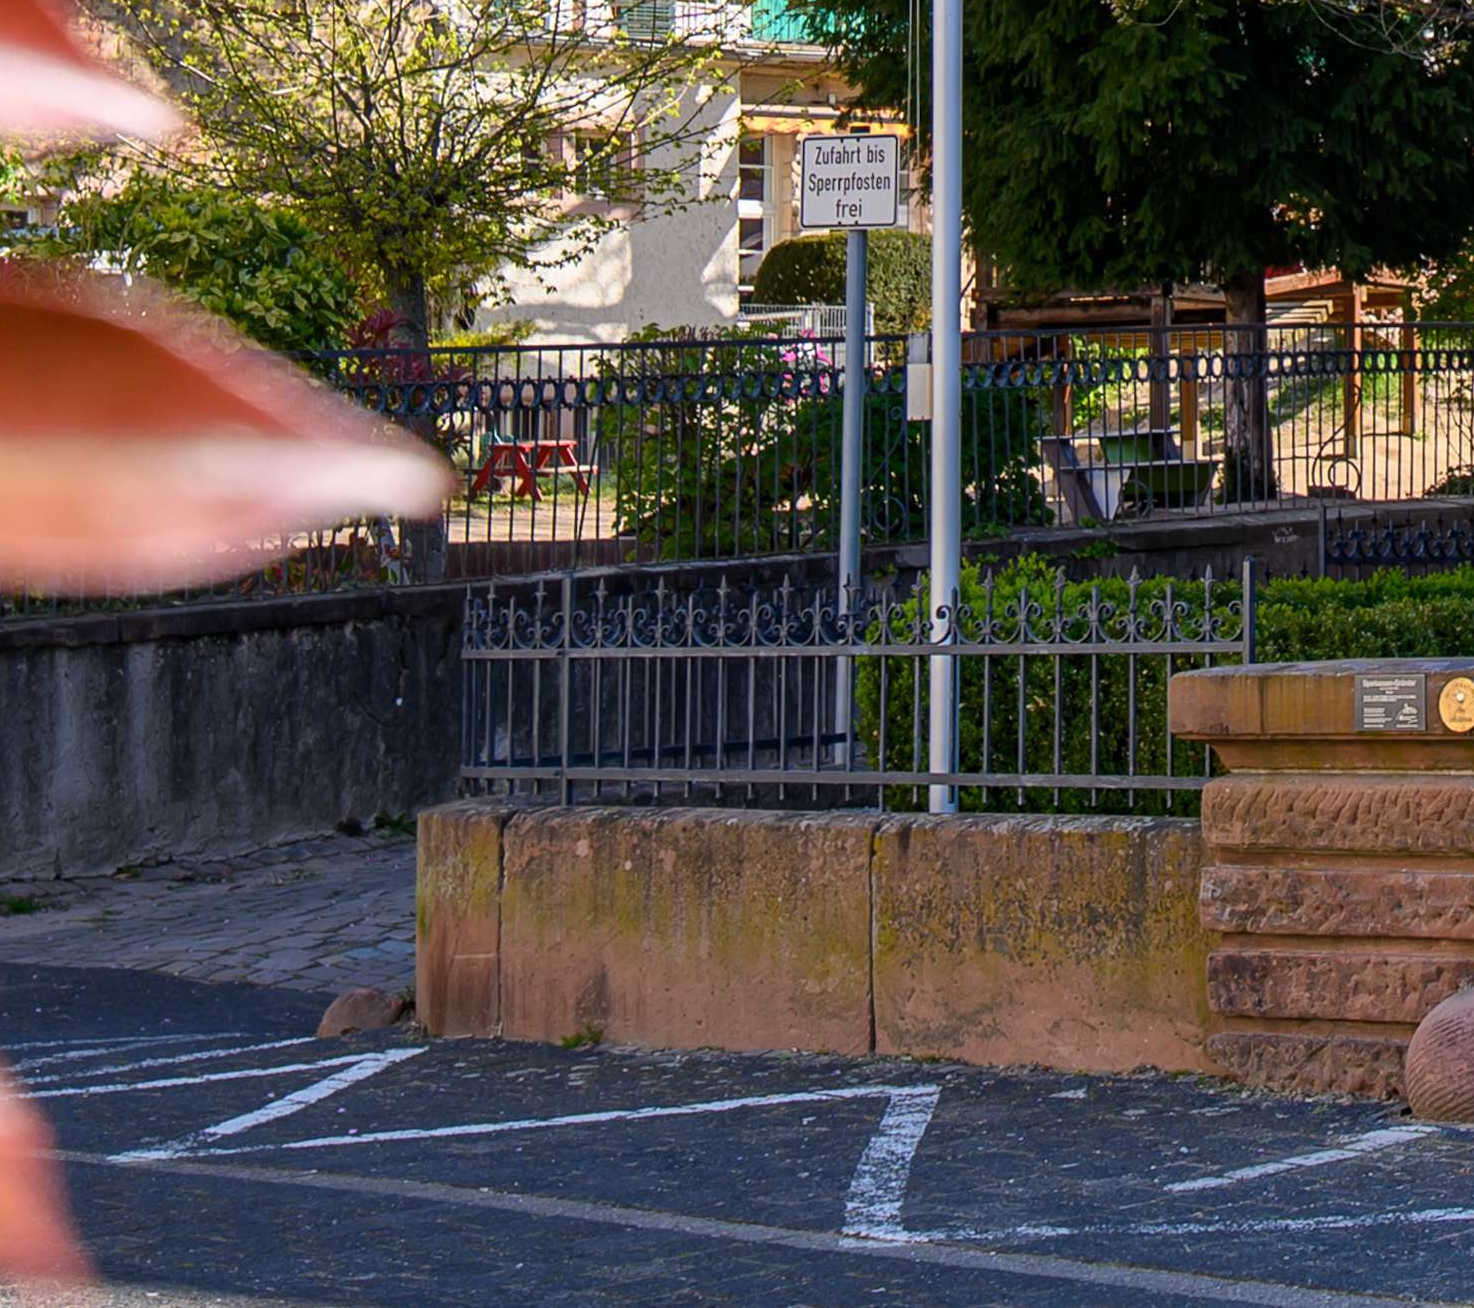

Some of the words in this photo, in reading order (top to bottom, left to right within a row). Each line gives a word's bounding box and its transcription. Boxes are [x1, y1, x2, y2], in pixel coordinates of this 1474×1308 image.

[815, 146, 861, 165] Zufahrt
[867, 145, 885, 163] bis
[808, 172, 891, 196] Sperrpfosten
[836, 198, 862, 218] frei
